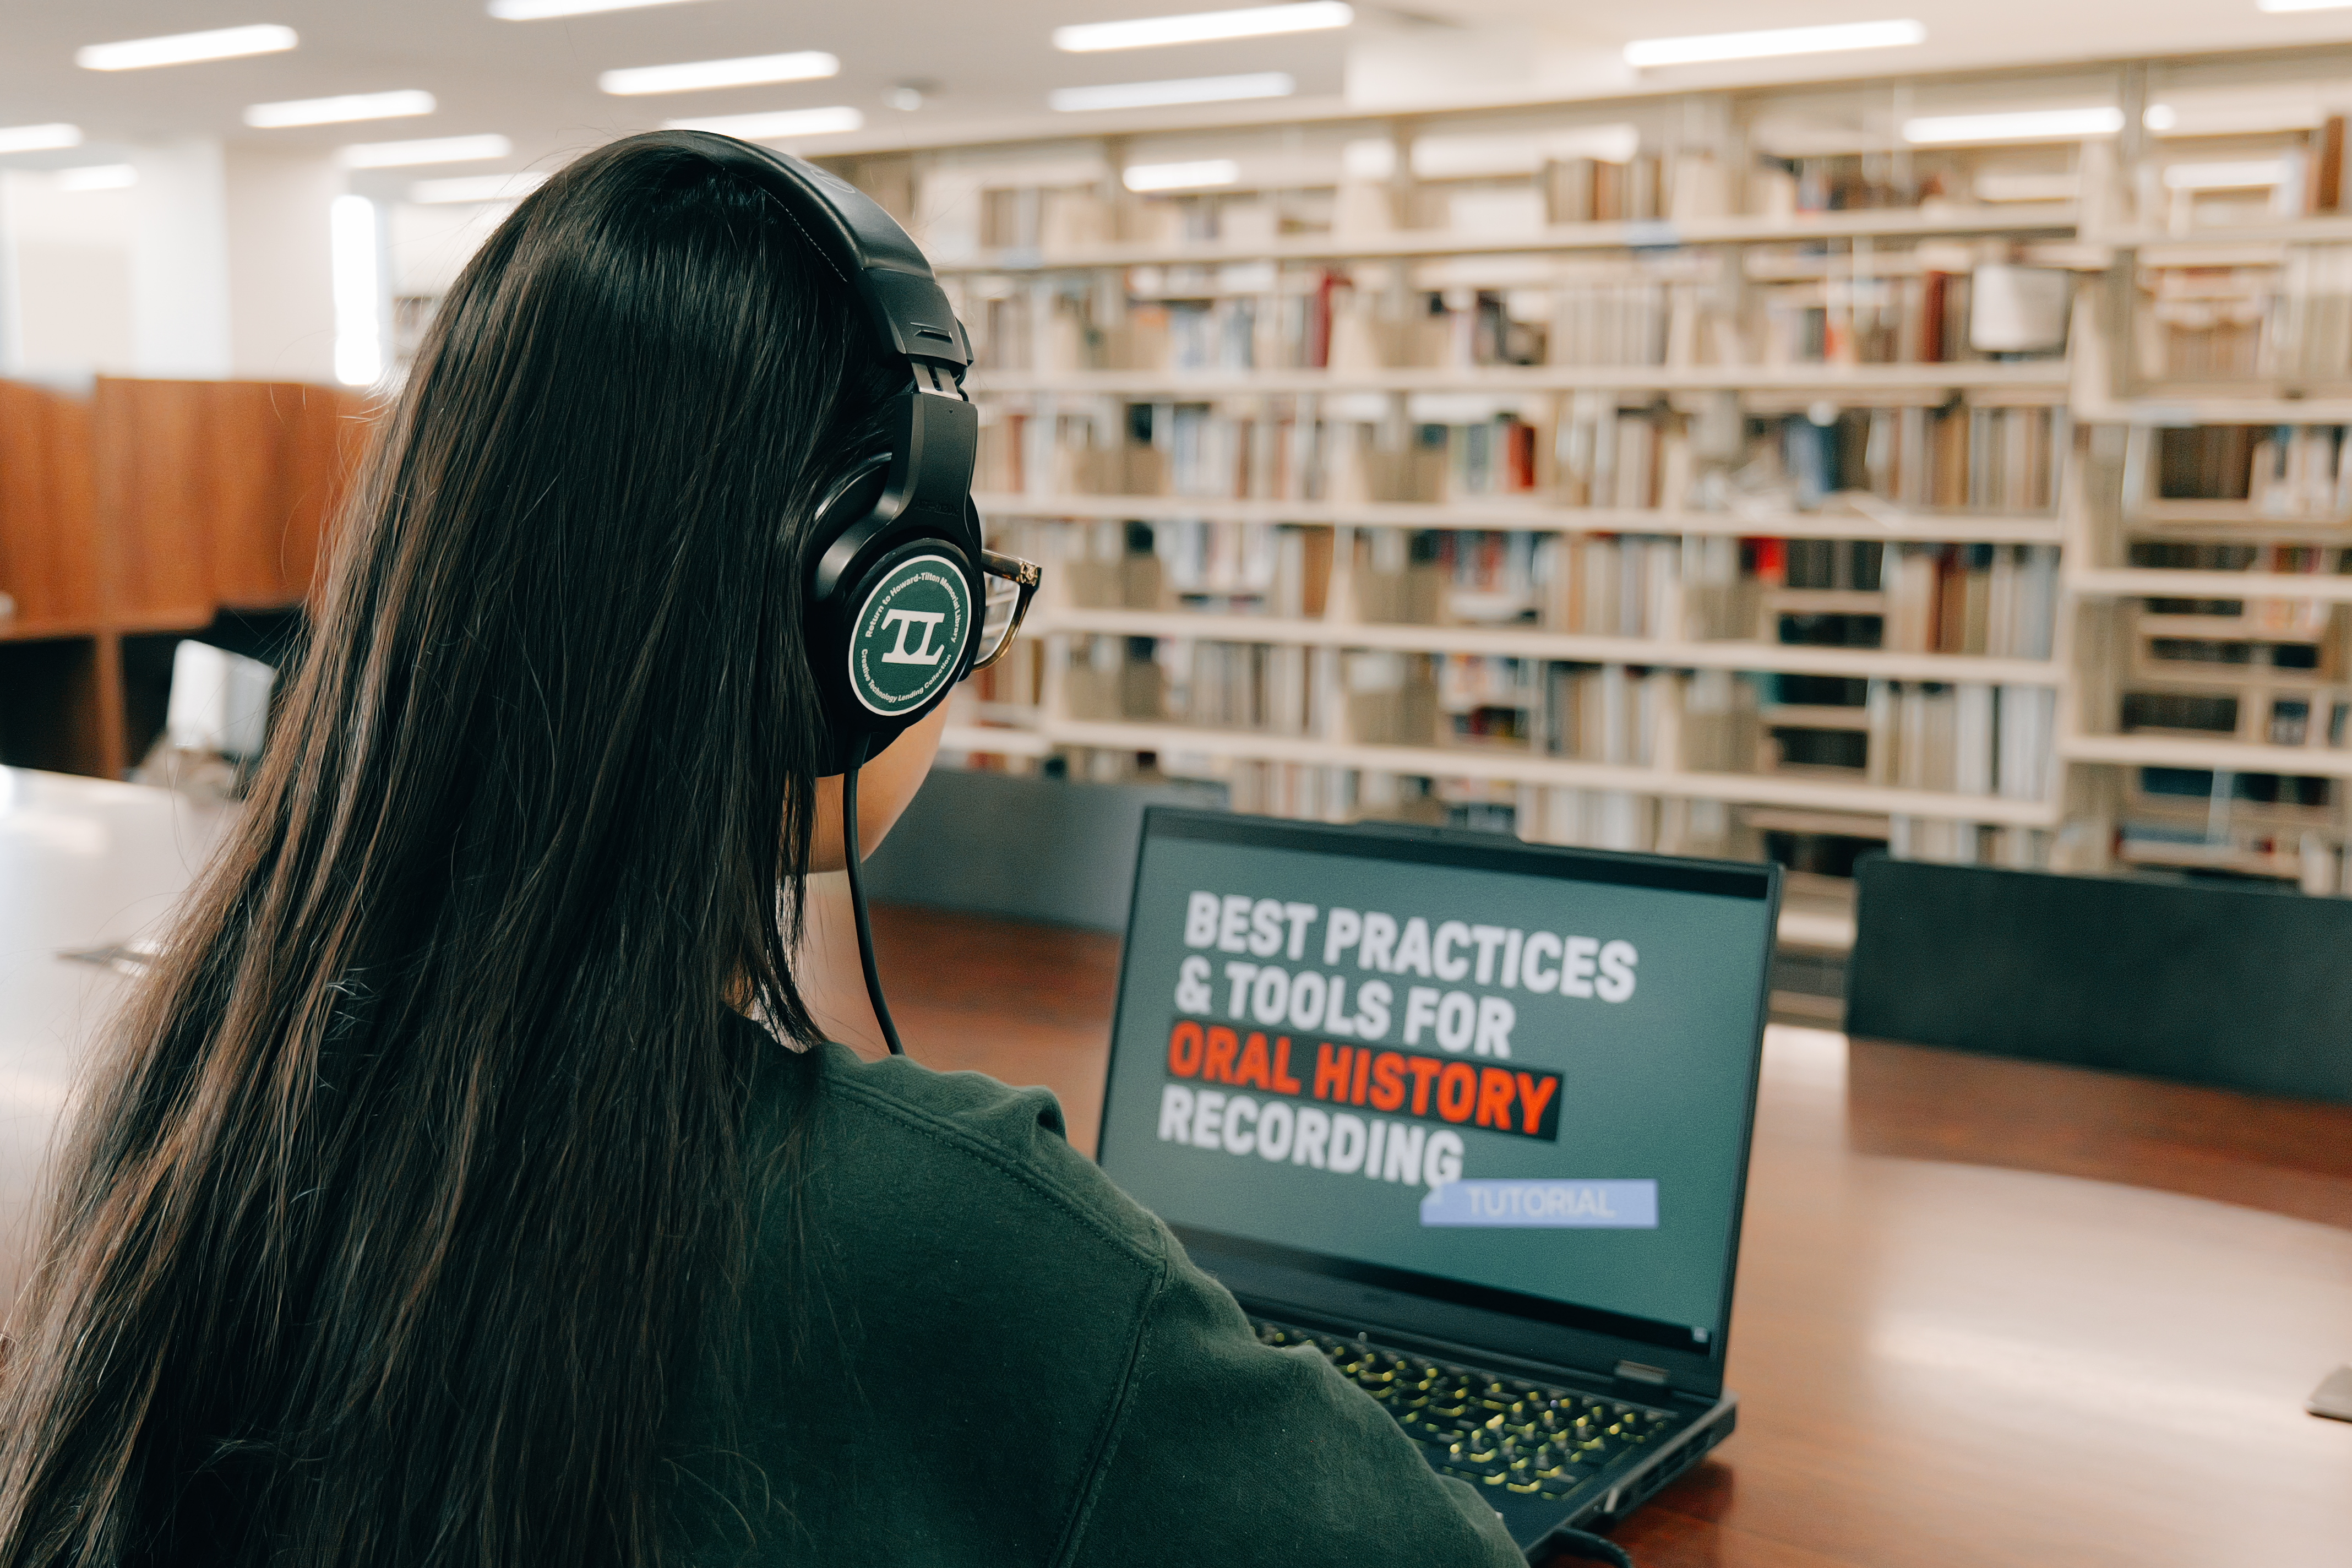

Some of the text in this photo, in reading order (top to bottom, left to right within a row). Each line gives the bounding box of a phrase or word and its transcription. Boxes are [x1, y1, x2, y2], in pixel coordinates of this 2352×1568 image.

[865, 571, 961, 643] Return to Howard-Tilton Memorial Library
[861, 649, 952, 703] Creative Technology Lending Collection
[1184, 890, 1639, 1003] BEST PRACTICES
[1174, 955, 1516, 1059] & TOOLS FOR
[1168, 1020, 1559, 1135] ORAL HISTORY
[1158, 1083, 1465, 1188] RECORDING
[1466, 1186, 1618, 1218] TUTORIAL
